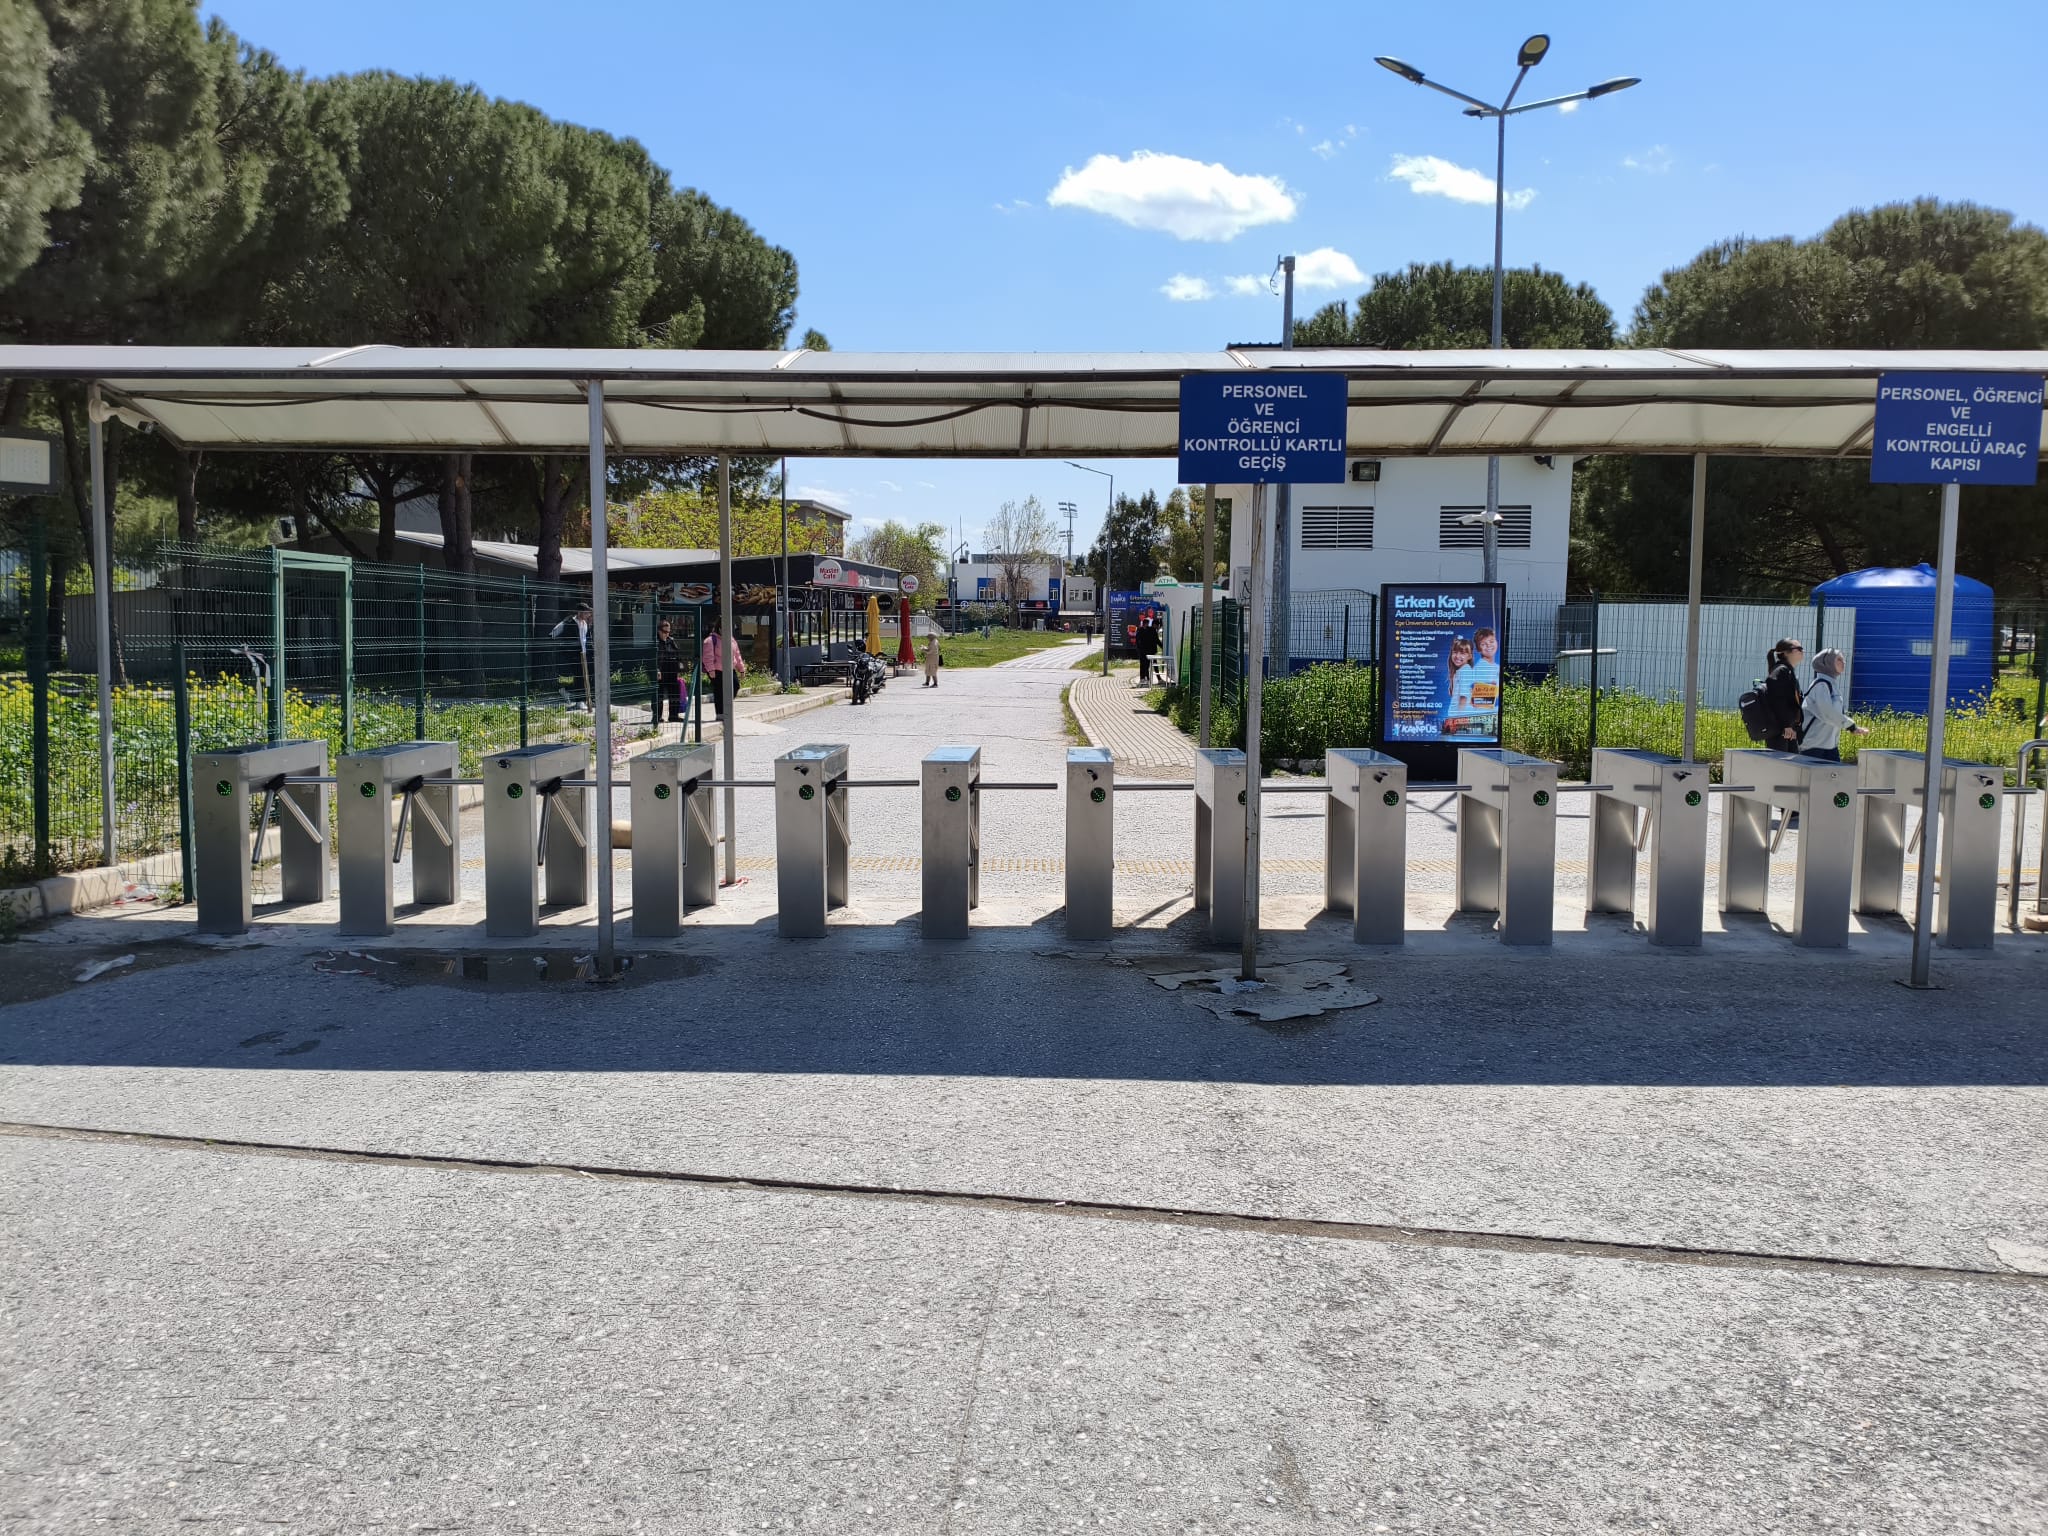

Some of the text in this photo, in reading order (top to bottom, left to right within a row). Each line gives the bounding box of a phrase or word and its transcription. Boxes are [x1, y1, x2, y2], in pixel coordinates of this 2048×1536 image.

[1222, 385, 1308, 398] PERSONEL
[1881, 387, 2043, 404] PERSONEL, ÖĞRENCİ
[1254, 403, 1274, 416] VE
[1951, 406, 1971, 419] VE
[1227, 418, 1300, 434] ÖĞRENCİ
[1926, 422, 1992, 437] ENGELLİ
[1184, 436, 1342, 452] KONTROLLÜ KARTLI
[1886, 439, 2027, 458] KONTROLLÜ ARAÇ
[1238, 453, 1286, 472] GEÇİŞ
[1931, 457, 1981, 471] KAPISI
[1395, 595, 1475, 611] Erken Kayıt
[1438, 609, 1465, 619] Başladı
